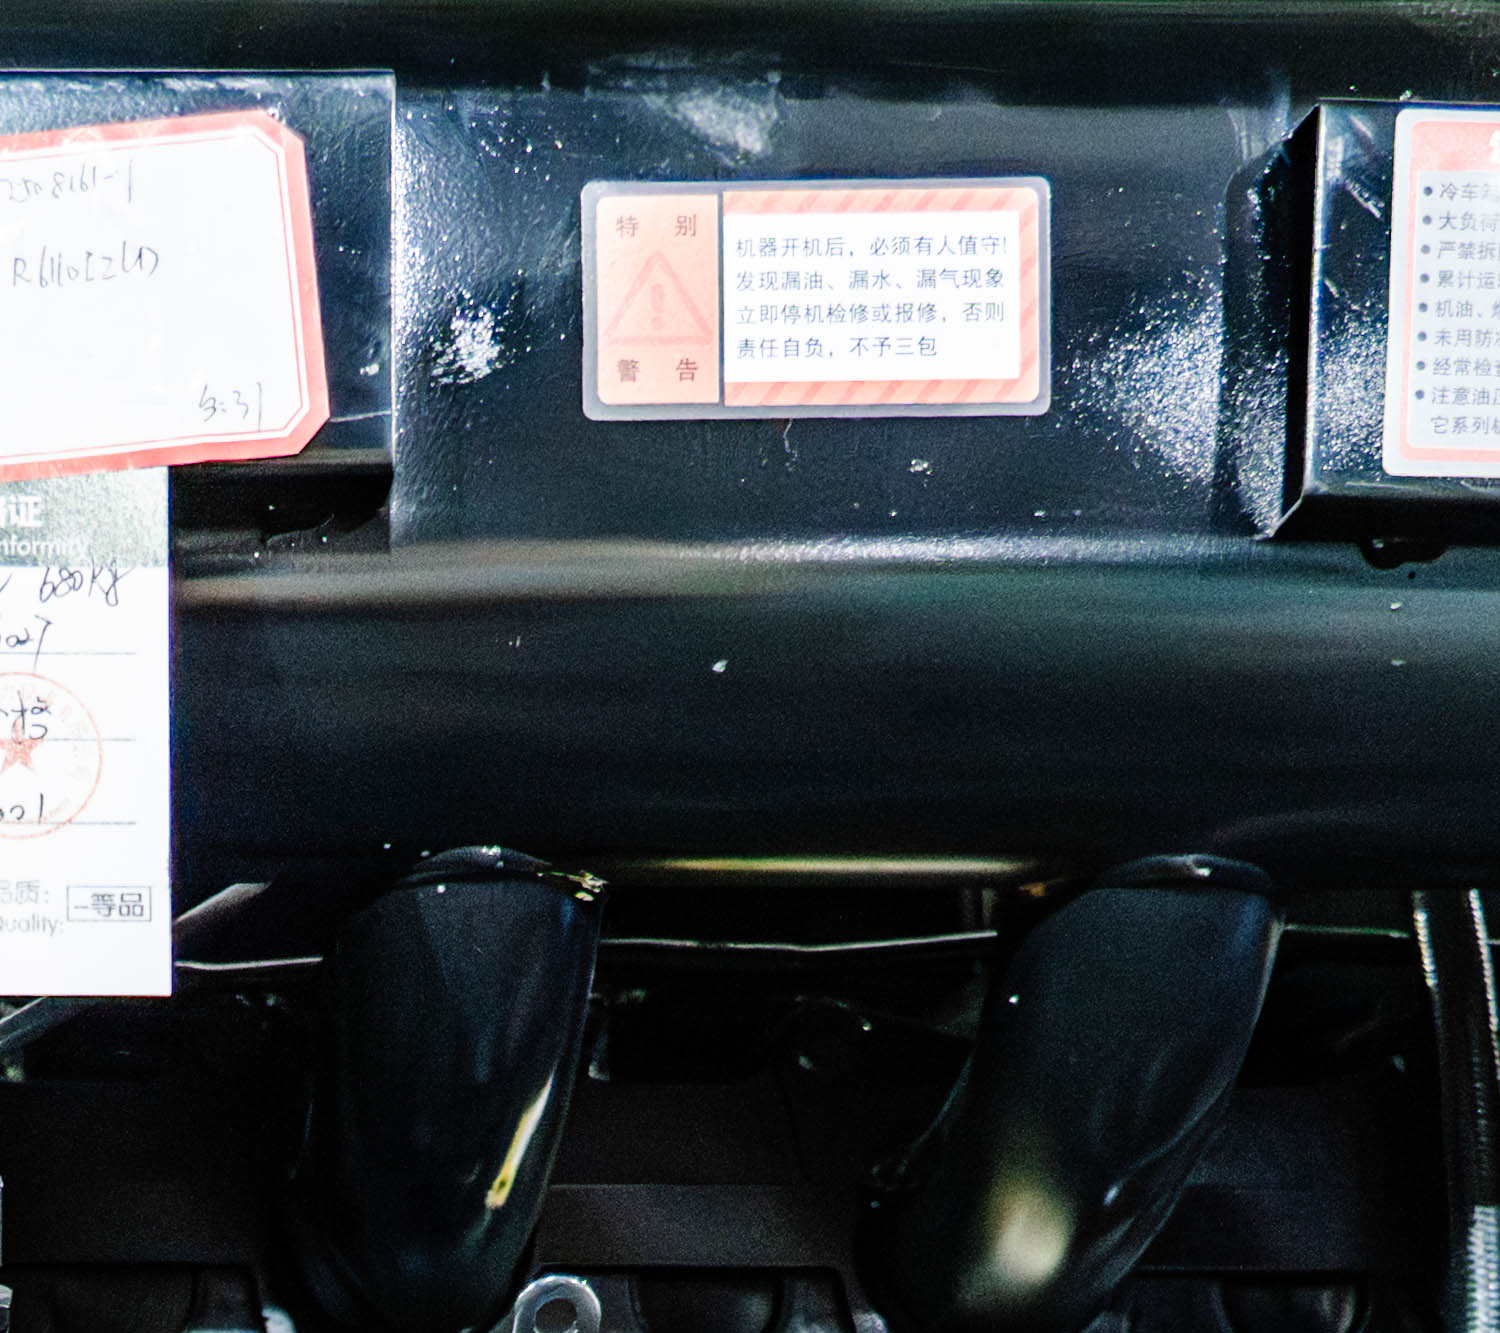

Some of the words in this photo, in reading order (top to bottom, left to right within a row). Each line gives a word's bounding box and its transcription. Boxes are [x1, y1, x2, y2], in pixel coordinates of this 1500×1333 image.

[616, 214, 697, 237] 特别
[736, 267, 1004, 292] 发现漏油、漏水、漏气现象
[736, 335, 938, 359] 责任自负,不予三包
[617, 358, 698, 383] 警告
